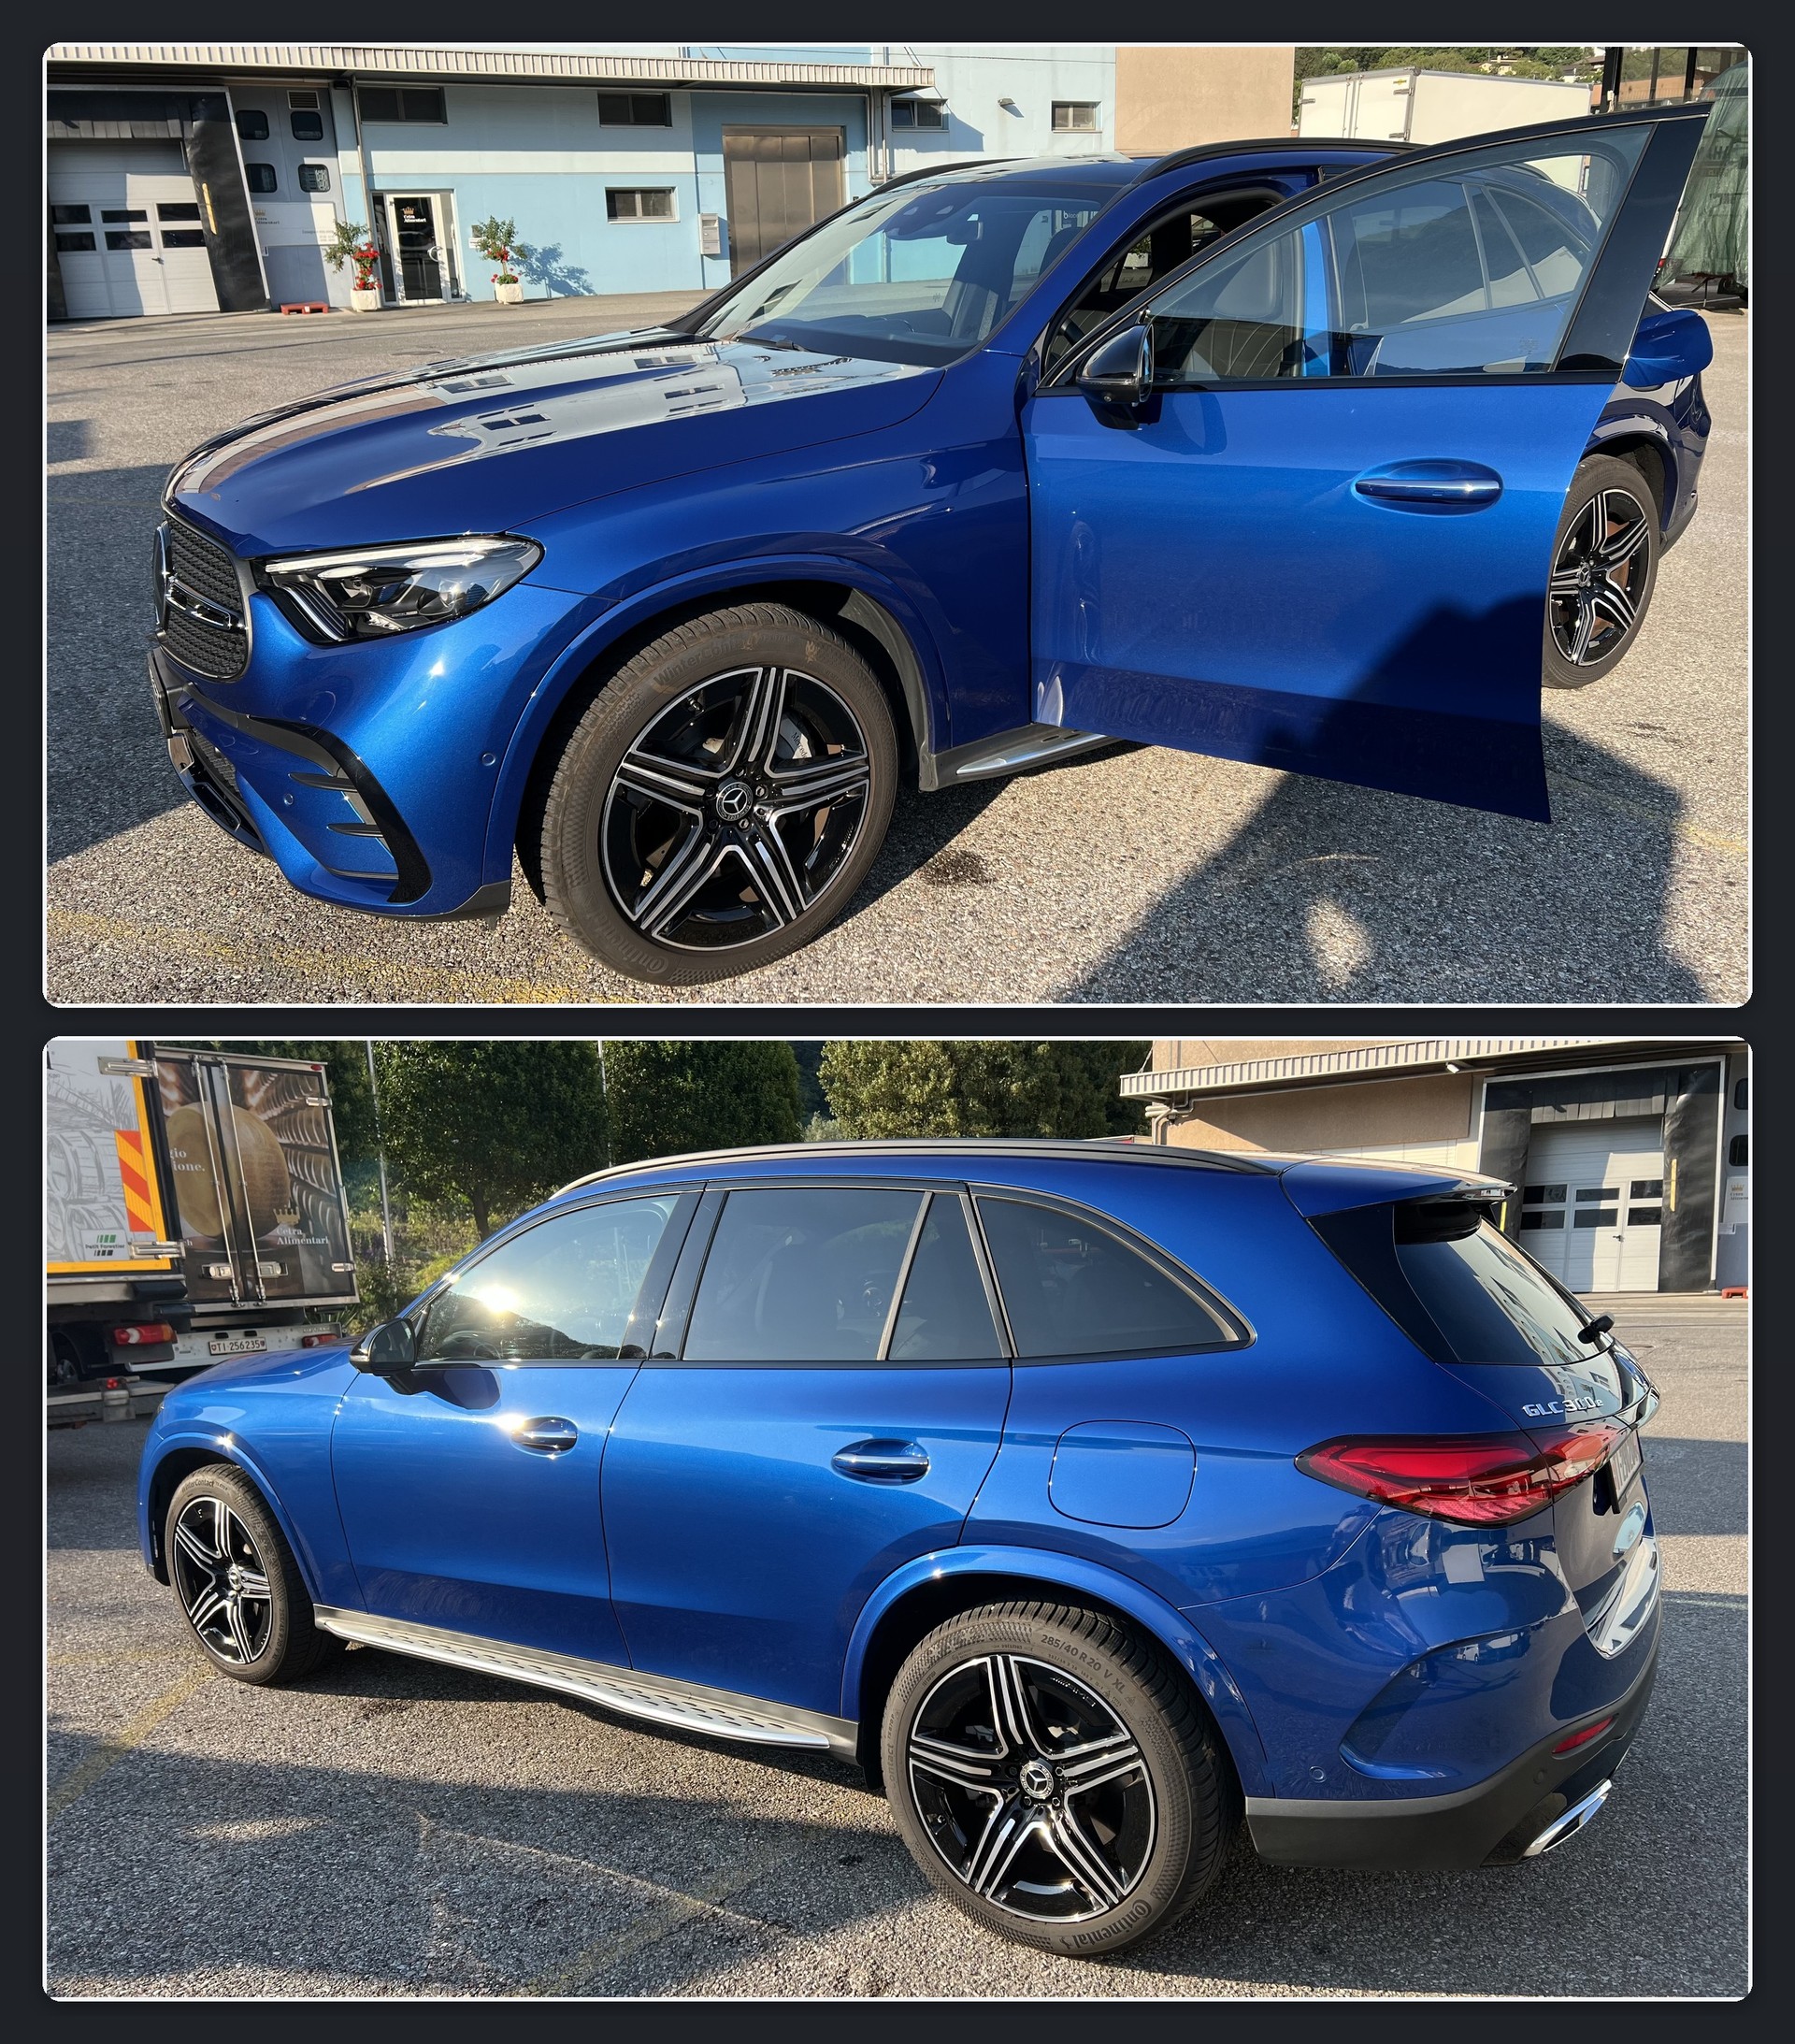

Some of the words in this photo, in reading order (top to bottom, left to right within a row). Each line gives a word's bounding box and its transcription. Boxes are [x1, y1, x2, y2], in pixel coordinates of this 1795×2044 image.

[277, 1227, 303, 1235] Cetra
[277, 1235, 329, 1245] Alimentari
[1522, 1401, 1564, 1417] GLC
[1041, 1634, 1079, 1658] 285/40
[1079, 1651, 1088, 1663] R
[1086, 1657, 1101, 1672] 20
[1103, 1669, 1113, 1679] V
[1113, 1678, 1127, 1694] XL
[1071, 1899, 1152, 1949] Continental
